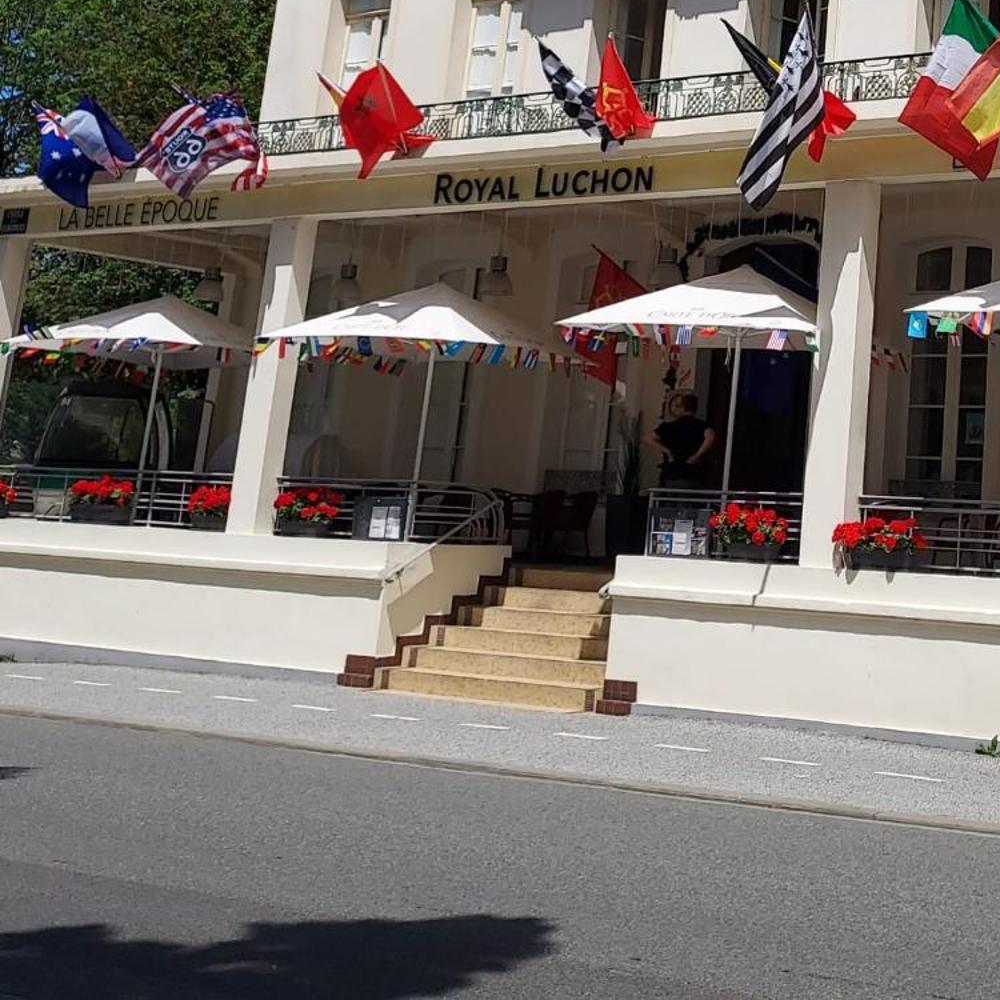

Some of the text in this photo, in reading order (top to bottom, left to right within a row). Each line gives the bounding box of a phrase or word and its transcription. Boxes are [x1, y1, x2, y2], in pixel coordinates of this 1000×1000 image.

[433, 166, 654, 204] ROYAL LUCHON
[58, 207, 79, 231] LA
[84, 202, 136, 229] BELLE
[140, 196, 220, 226] ÉPOQUE
